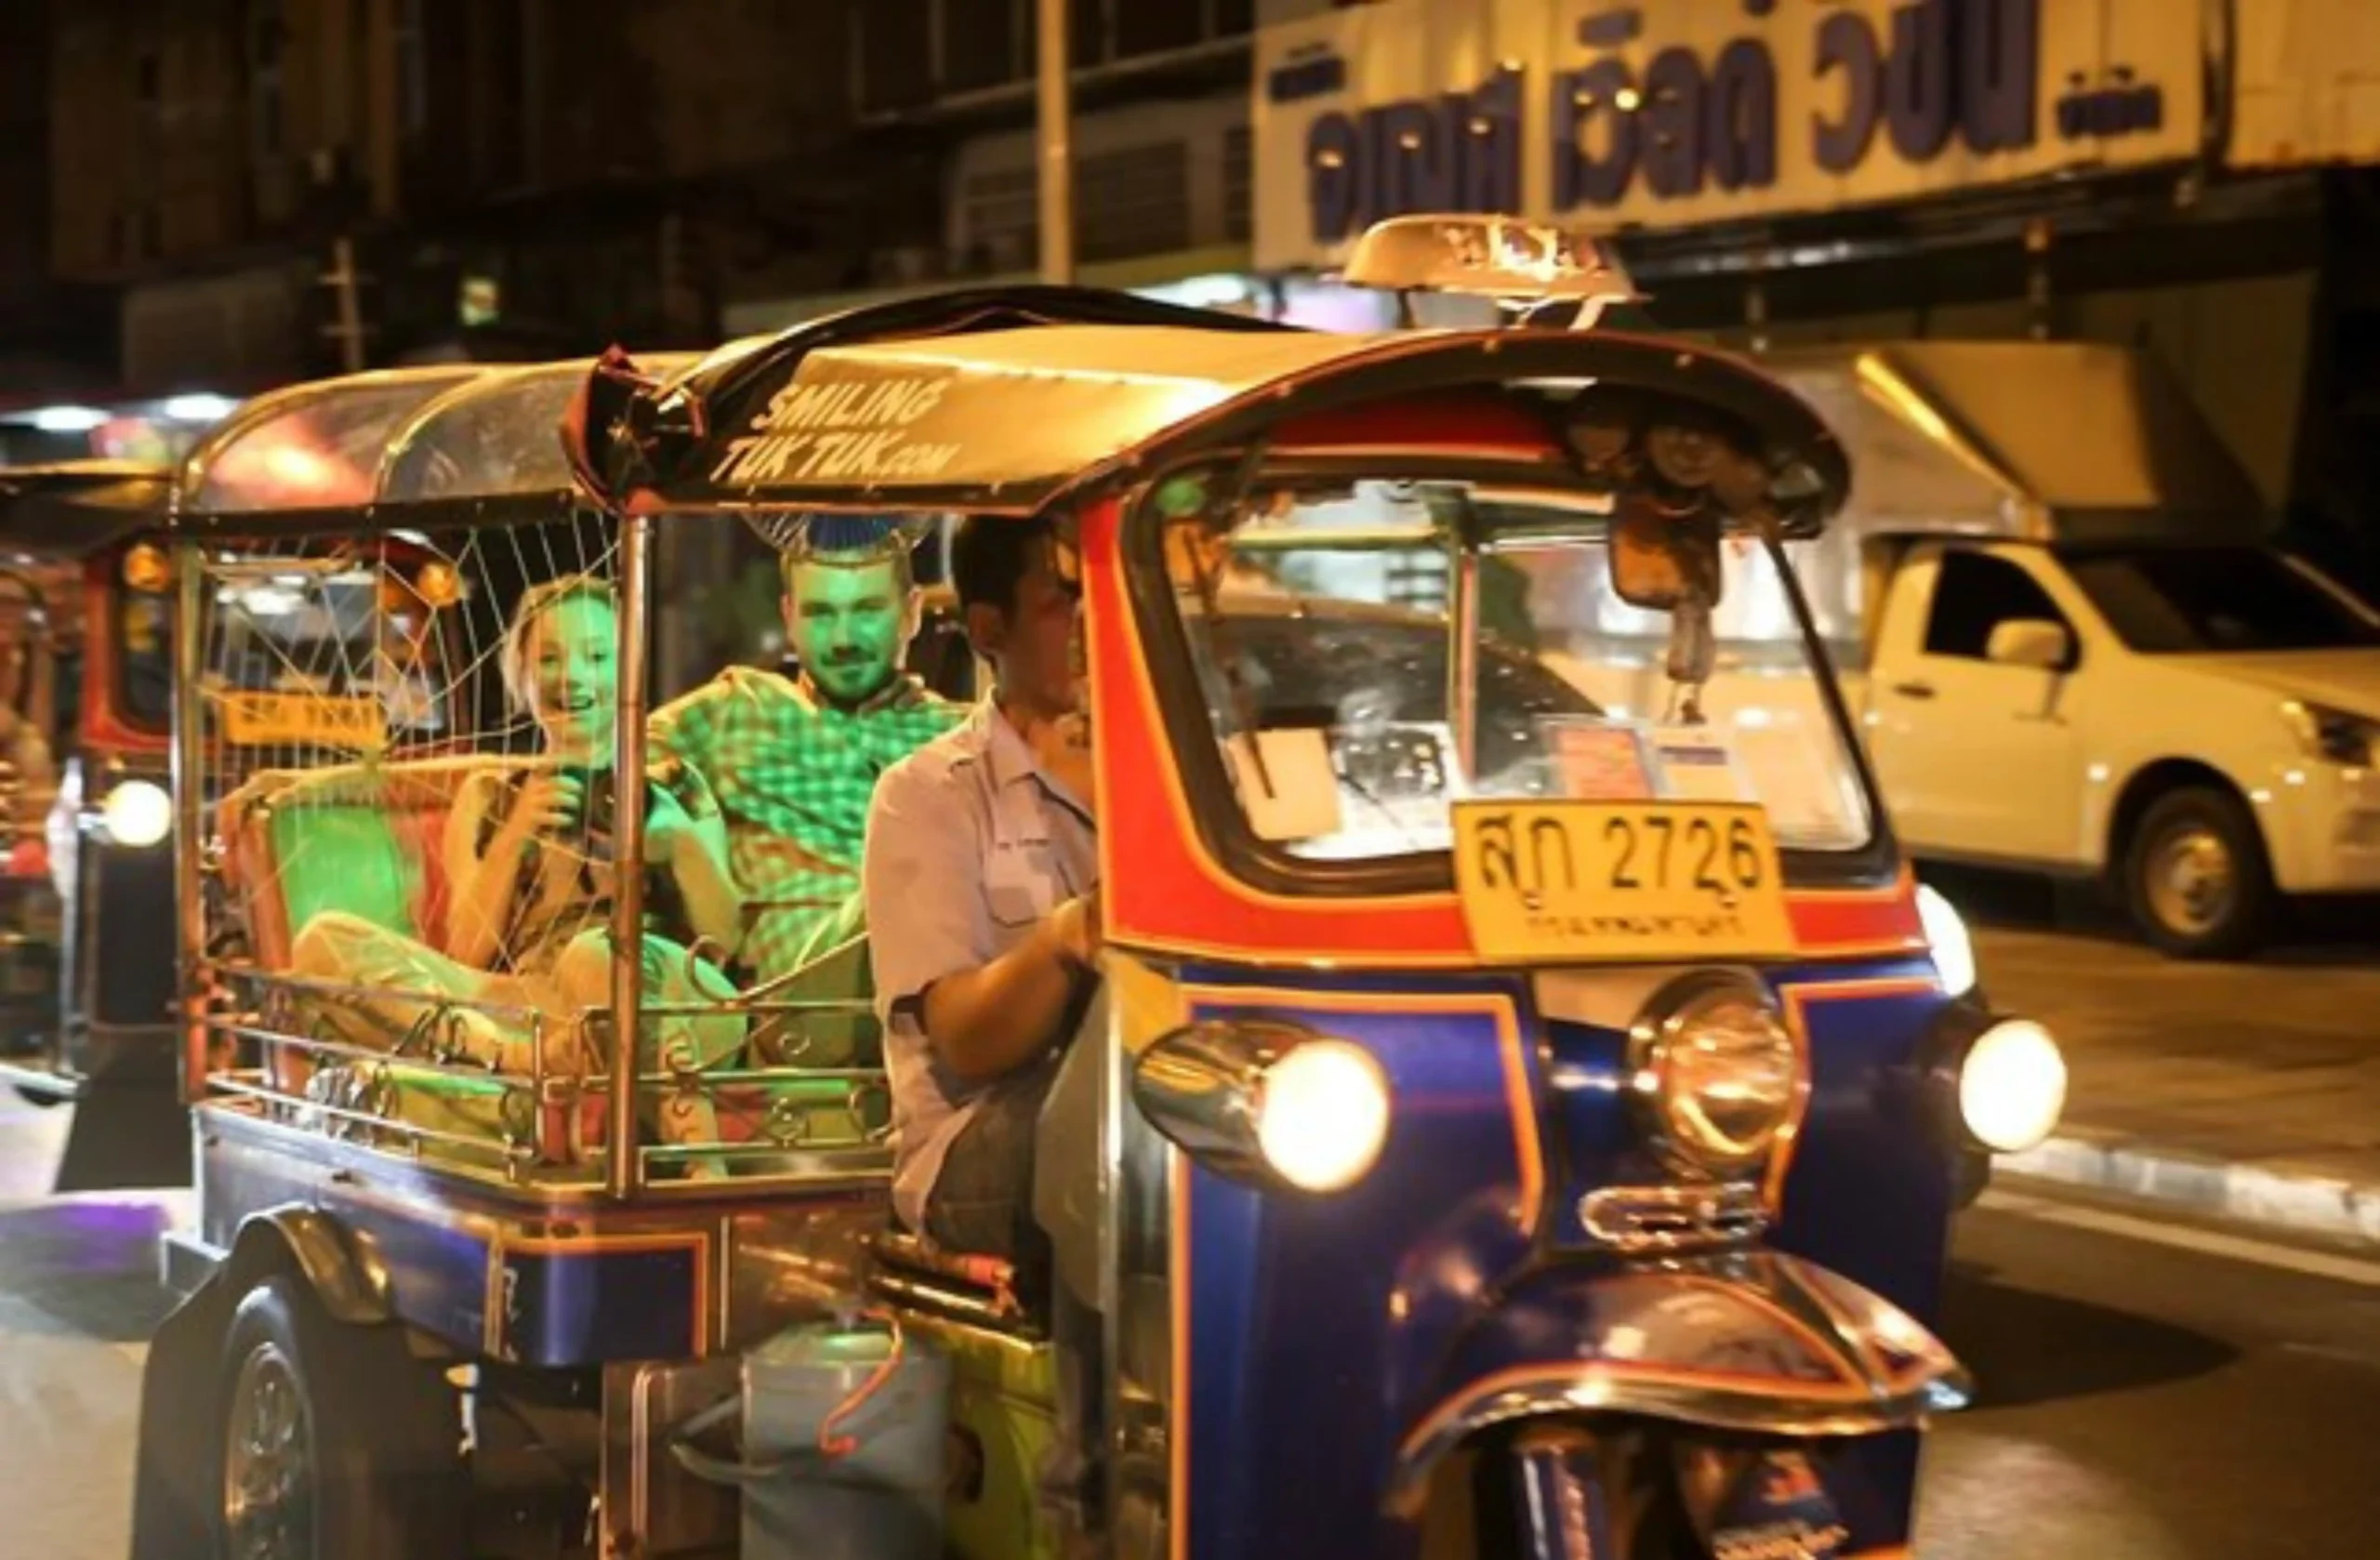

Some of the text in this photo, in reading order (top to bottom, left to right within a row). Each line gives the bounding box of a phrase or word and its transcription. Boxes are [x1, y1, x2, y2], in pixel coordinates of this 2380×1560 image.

[750, 378, 951, 430] SMILING
[709, 434, 814, 482] TUK
[1603, 816, 1761, 889] 2726
